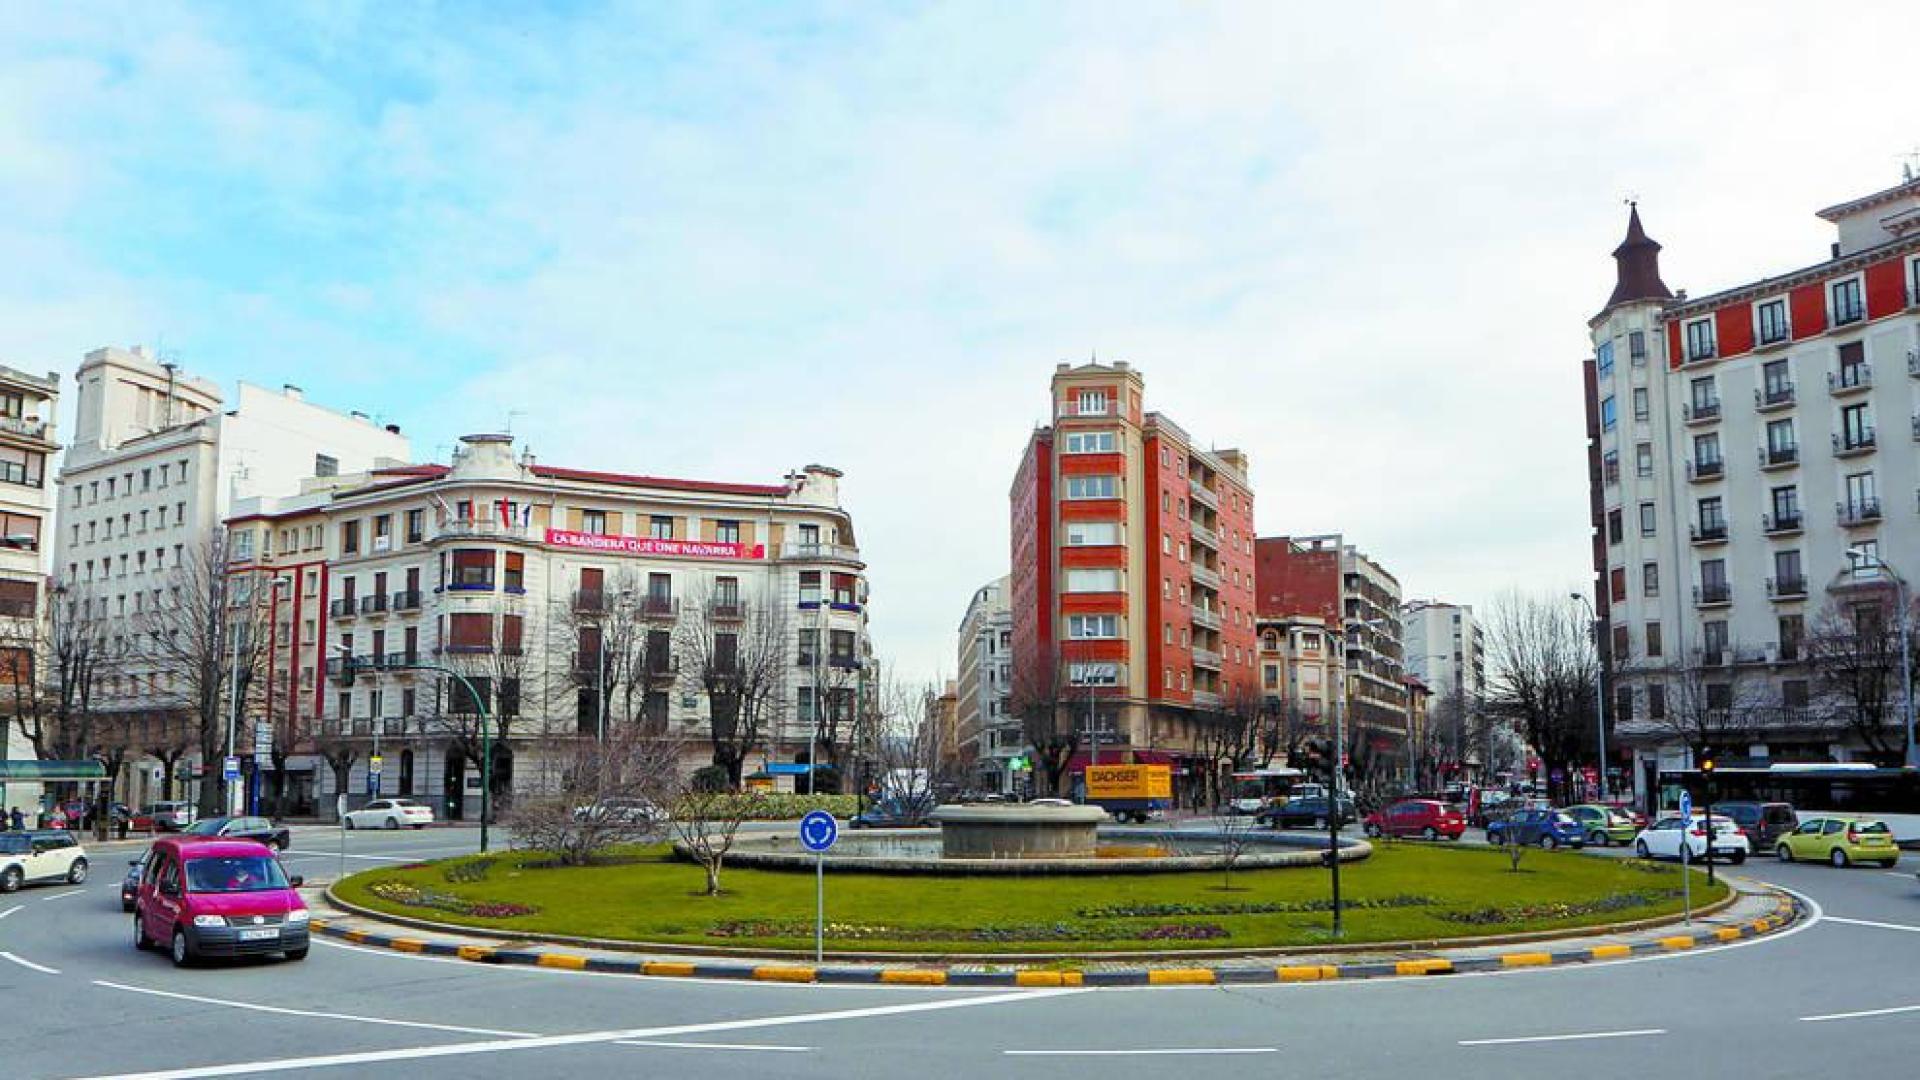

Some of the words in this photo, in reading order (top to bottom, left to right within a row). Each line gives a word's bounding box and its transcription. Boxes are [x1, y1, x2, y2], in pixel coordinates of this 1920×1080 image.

[554, 533, 569, 544] LA
[570, 534, 625, 550] BANDERA
[628, 540, 653, 553] QUE
[655, 542, 678, 555] UNE
[682, 544, 736, 557] NAVARRA
[1092, 770, 1139, 782] DACHSER
